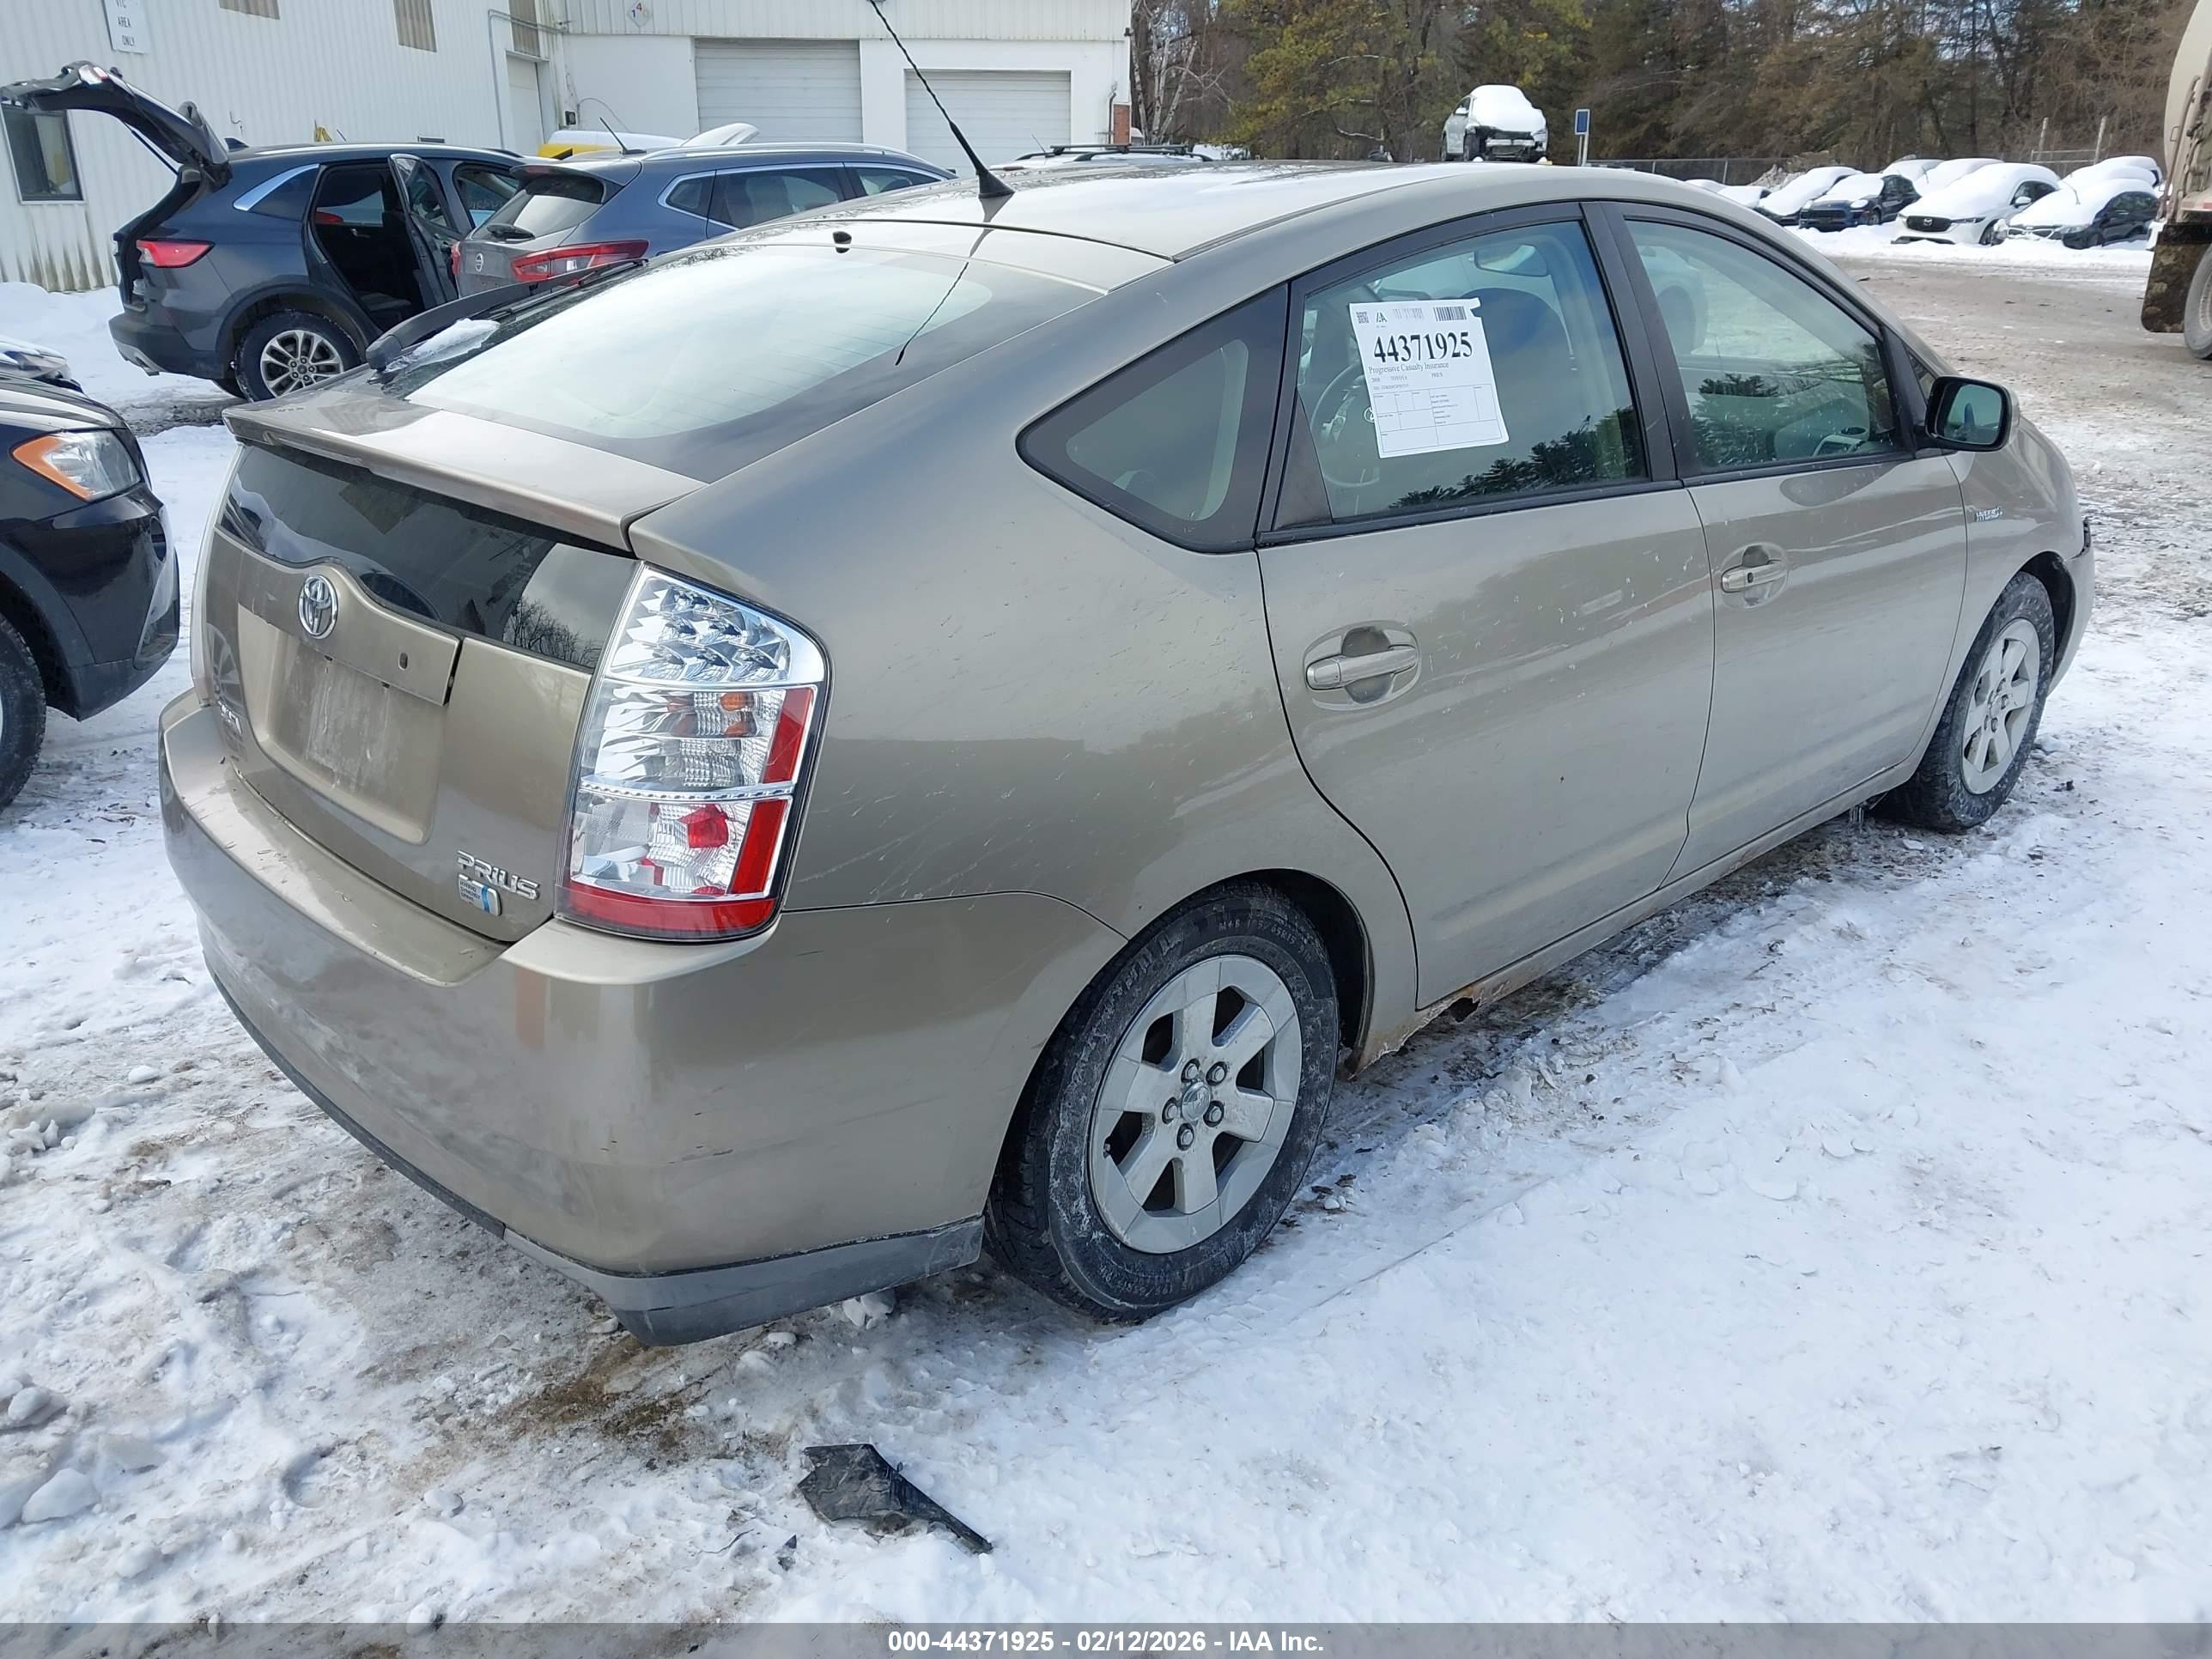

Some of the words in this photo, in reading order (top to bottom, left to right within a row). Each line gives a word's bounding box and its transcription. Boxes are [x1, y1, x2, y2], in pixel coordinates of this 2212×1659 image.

[1374, 331, 1473, 363] 44371925
[1369, 366, 1400, 374] Progressive
[1401, 363, 1424, 372] Casualty
[1425, 362, 1449, 370] Insurance
[458, 850, 538, 900] PRIUS
